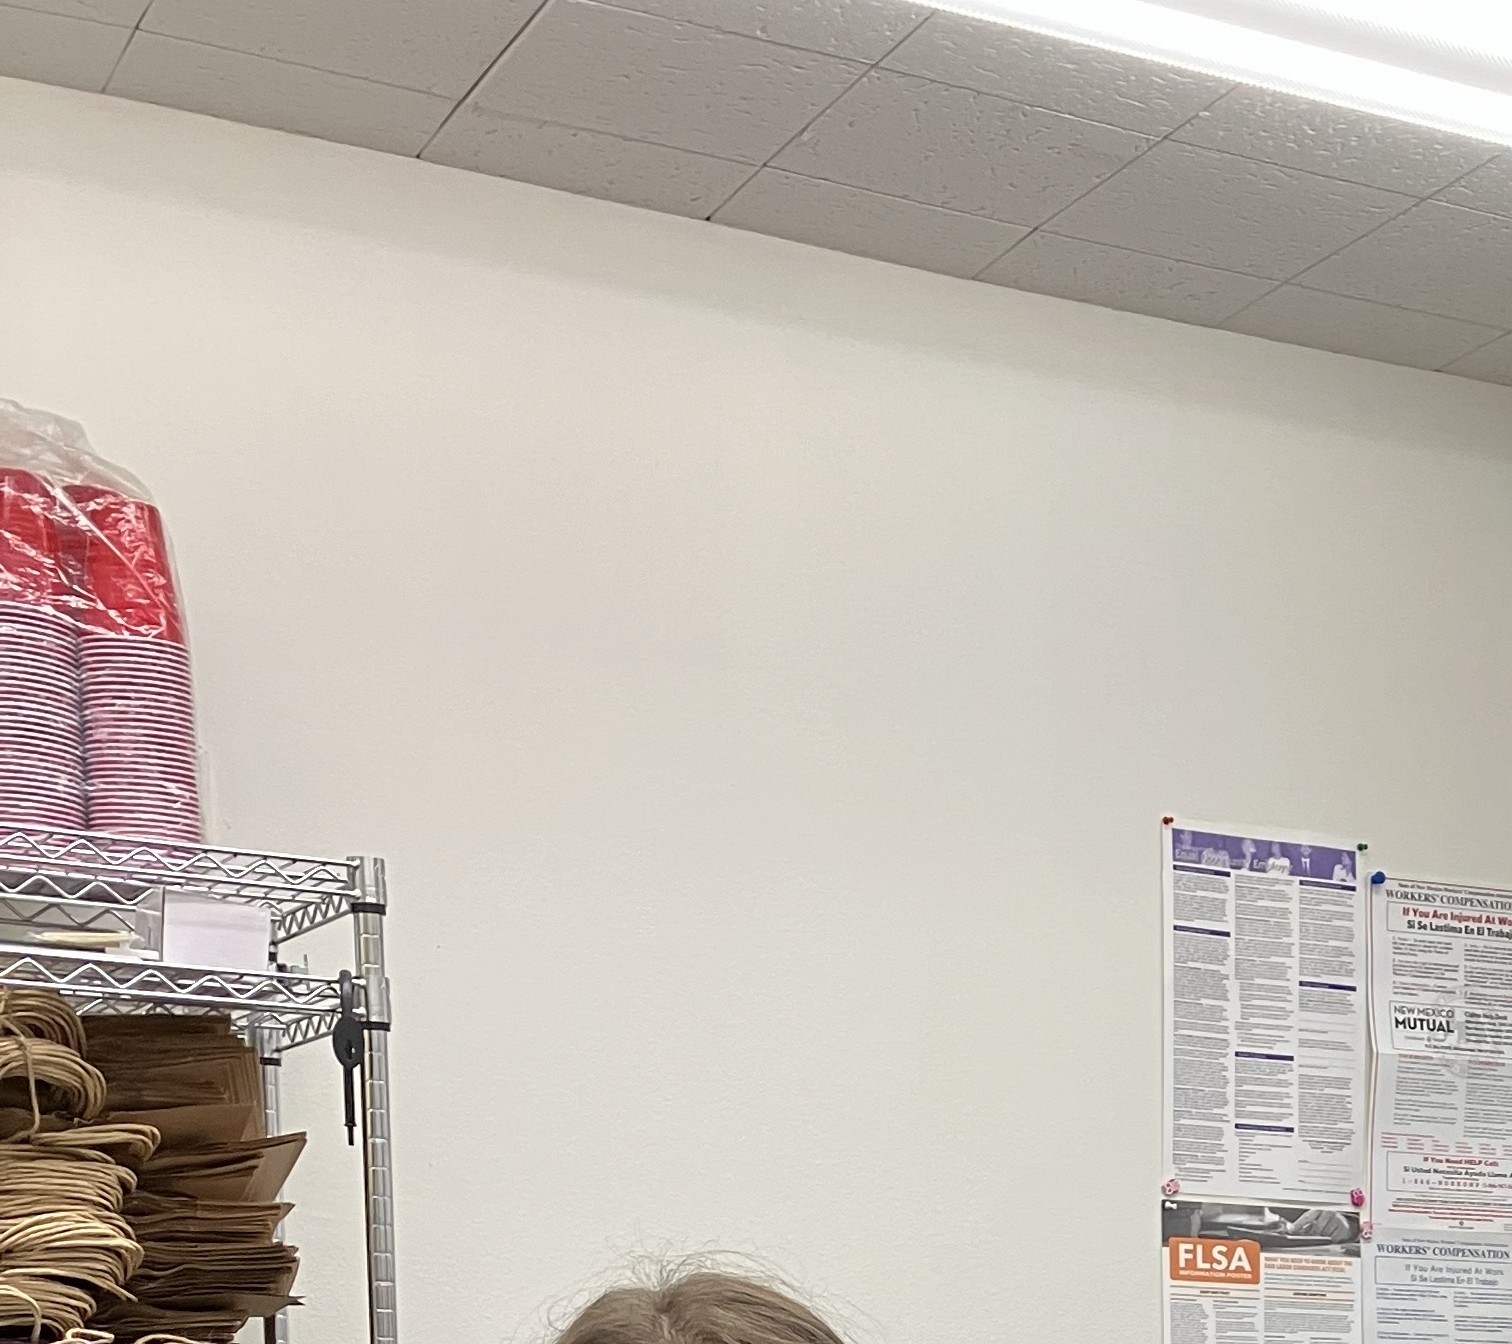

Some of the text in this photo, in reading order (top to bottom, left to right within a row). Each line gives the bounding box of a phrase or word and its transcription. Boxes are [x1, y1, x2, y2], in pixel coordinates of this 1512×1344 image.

[1386, 889, 1440, 904] WORKERS'
[1402, 907, 1411, 916] If
[1412, 908, 1430, 919] You
[1432, 910, 1448, 921] Are
[1450, 911, 1483, 923] Injured
[1484, 915, 1495, 924] At
[1407, 920, 1415, 929] Si
[1417, 921, 1428, 930] Se
[1430, 922, 1462, 934] Lastima
[1464, 925, 1475, 935] En
[1476, 926, 1485, 935] El
[1394, 1006, 1454, 1018] NEW MEXICO
[1395, 1016, 1454, 1033] MUTUAL
[1178, 1243, 1252, 1271] FLSA
[1376, 1243, 1431, 1255] WORKERS'
[1432, 1246, 1510, 1260] COMPENSATION
[1179, 1270, 1226, 1278] INFORMATION
[1405, 1263, 1411, 1271] If
[1413, 1264, 1428, 1273] You
[1430, 1265, 1443, 1273] Are
[1445, 1266, 1472, 1275] Injured
[1419, 1275, 1428, 1283] Se
